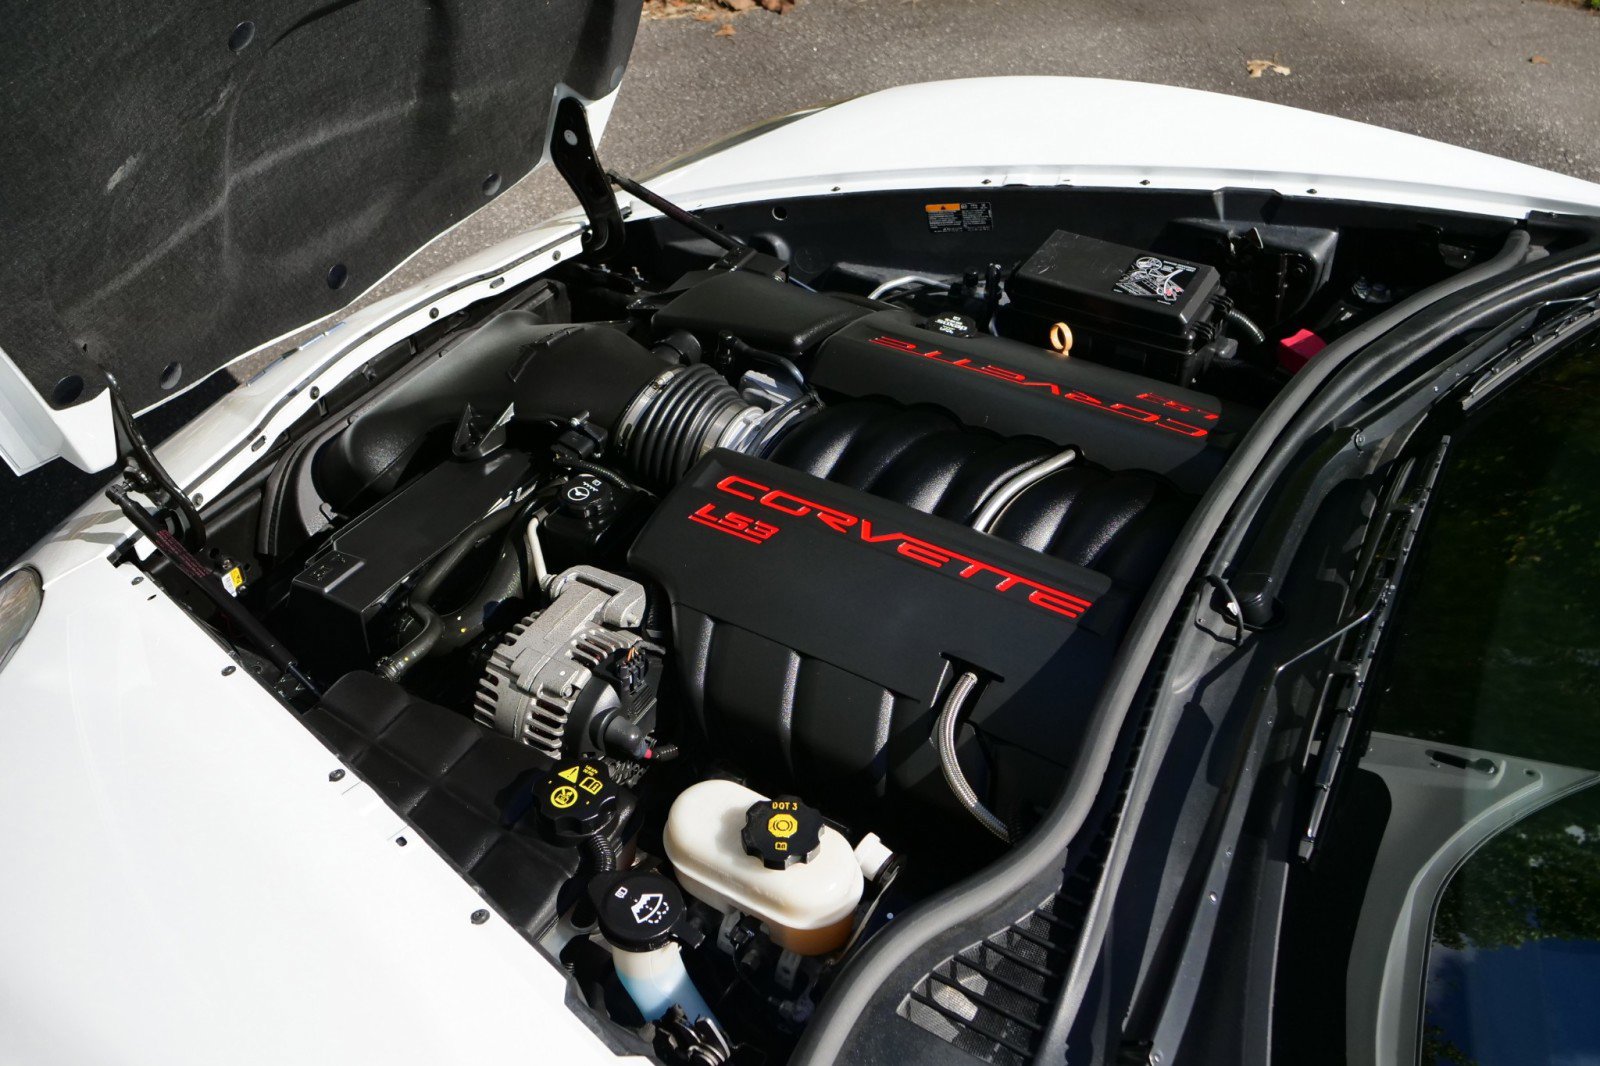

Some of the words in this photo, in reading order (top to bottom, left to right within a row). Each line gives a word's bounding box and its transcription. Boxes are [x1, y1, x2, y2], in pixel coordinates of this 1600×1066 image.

[869, 336, 1209, 438] CORVETTE
[690, 503, 780, 542] LS3
[716, 475, 1093, 619] CORVETTE
[772, 801, 790, 810] DOT
[792, 802, 798, 811] 3
